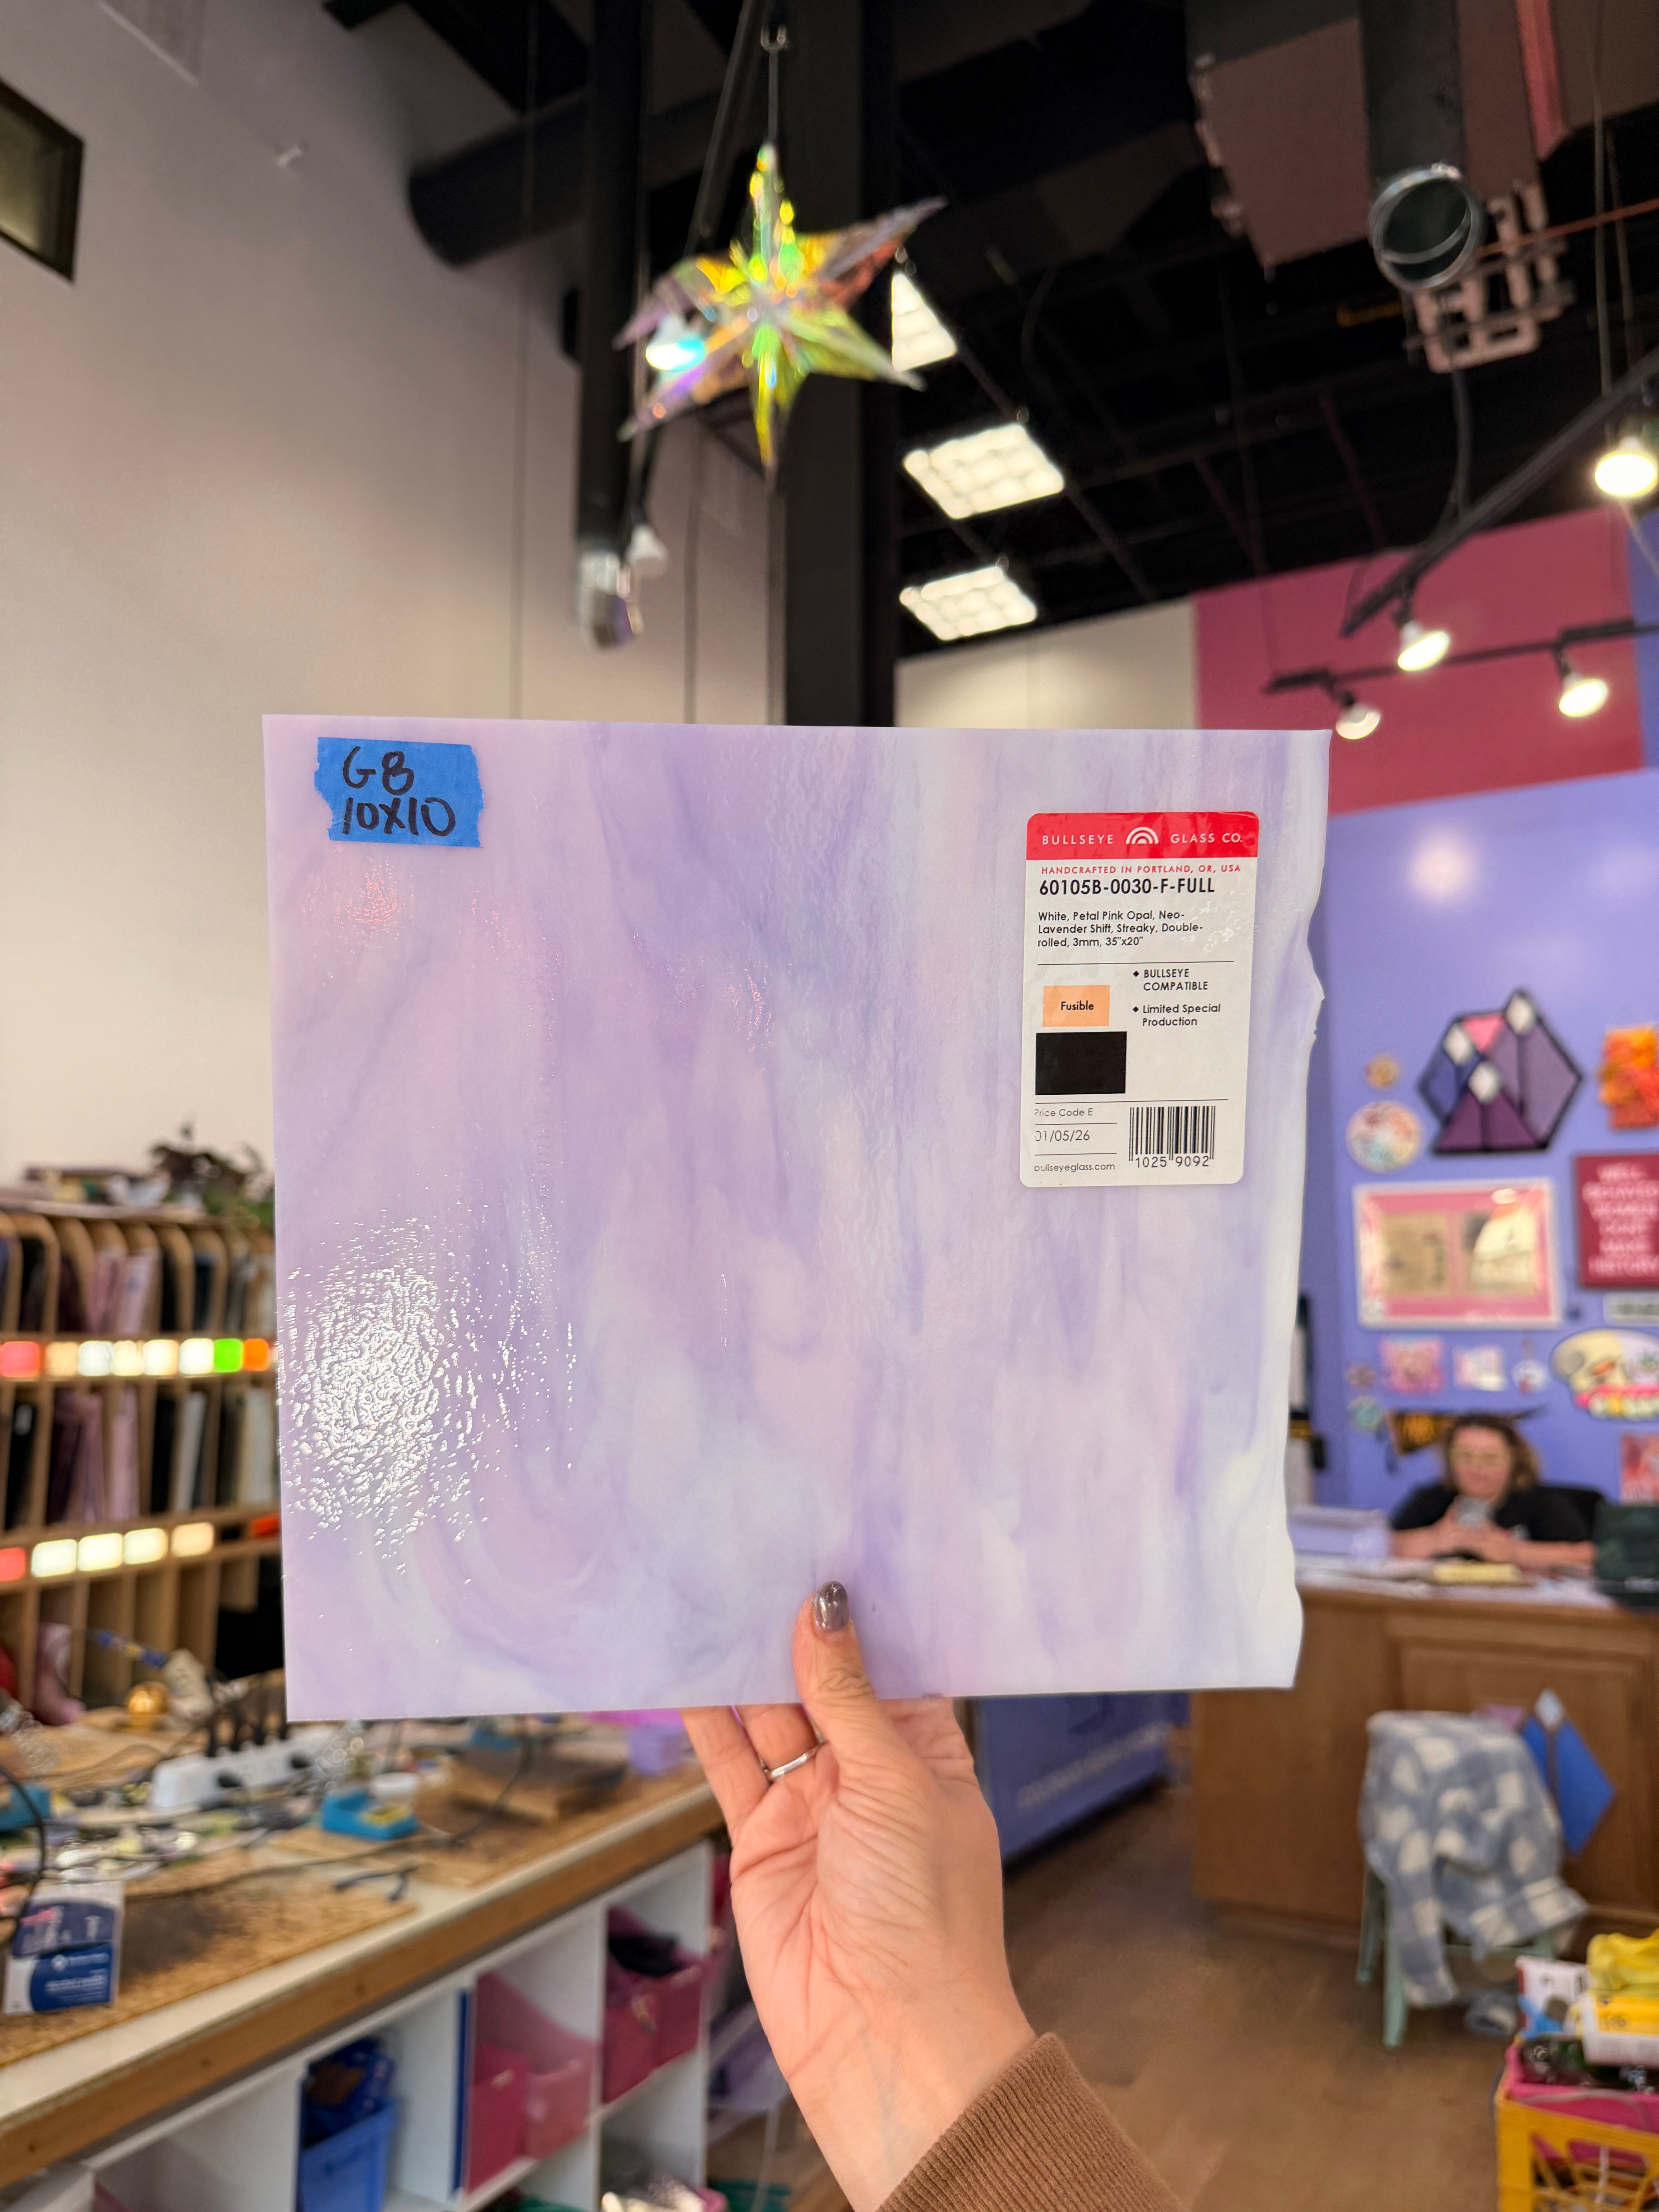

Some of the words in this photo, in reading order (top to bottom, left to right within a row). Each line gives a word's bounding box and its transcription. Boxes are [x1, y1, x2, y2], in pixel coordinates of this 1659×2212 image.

[1042, 835, 1113, 845] BULLSEYE
[1170, 833, 1214, 843] GLASS
[1222, 833, 1242, 843] CO.
[1041, 866, 1116, 874] HANDCRAFTED
[1137, 865, 1193, 874] PORTLAND,
[1198, 864, 1216, 874] OR,
[1220, 864, 1240, 873] USA
[1039, 878, 1215, 895] 60105B-0030-F-FULL
[1038, 912, 1069, 922] White,
[1073, 911, 1099, 920] Petal
[1103, 911, 1123, 920] Pink
[1127, 910, 1155, 921] Opal,
[1159, 910, 1185, 919] Neo-
[1039, 924, 1087, 934] Lavender
[1090, 924, 1113, 934] Shift,
[1117, 923, 1158, 934] Streaky,
[1162, 922, 1203, 932] Double-
[1038, 938, 1069, 948] rolled,
[1073, 938, 1102, 947] 3mm,
[1144, 969, 1189, 978] BULLSEYE
[1143, 981, 1208, 991] COMPATIBLE
[1061, 1000, 1094, 1010] Fusible
[1143, 1004, 1179, 1013] Limited
[1182, 1003, 1221, 1015] Special
[1142, 1017, 1197, 1026] Production
[1059, 1108, 1085, 1116] Code
[1035, 1130, 1090, 1142] 01/05/26
[1135, 1156, 1167, 1168] 1025
[1175, 1156, 1209, 1167] 9092
[1034, 1163, 1115, 1173] bullseyeglass.com
